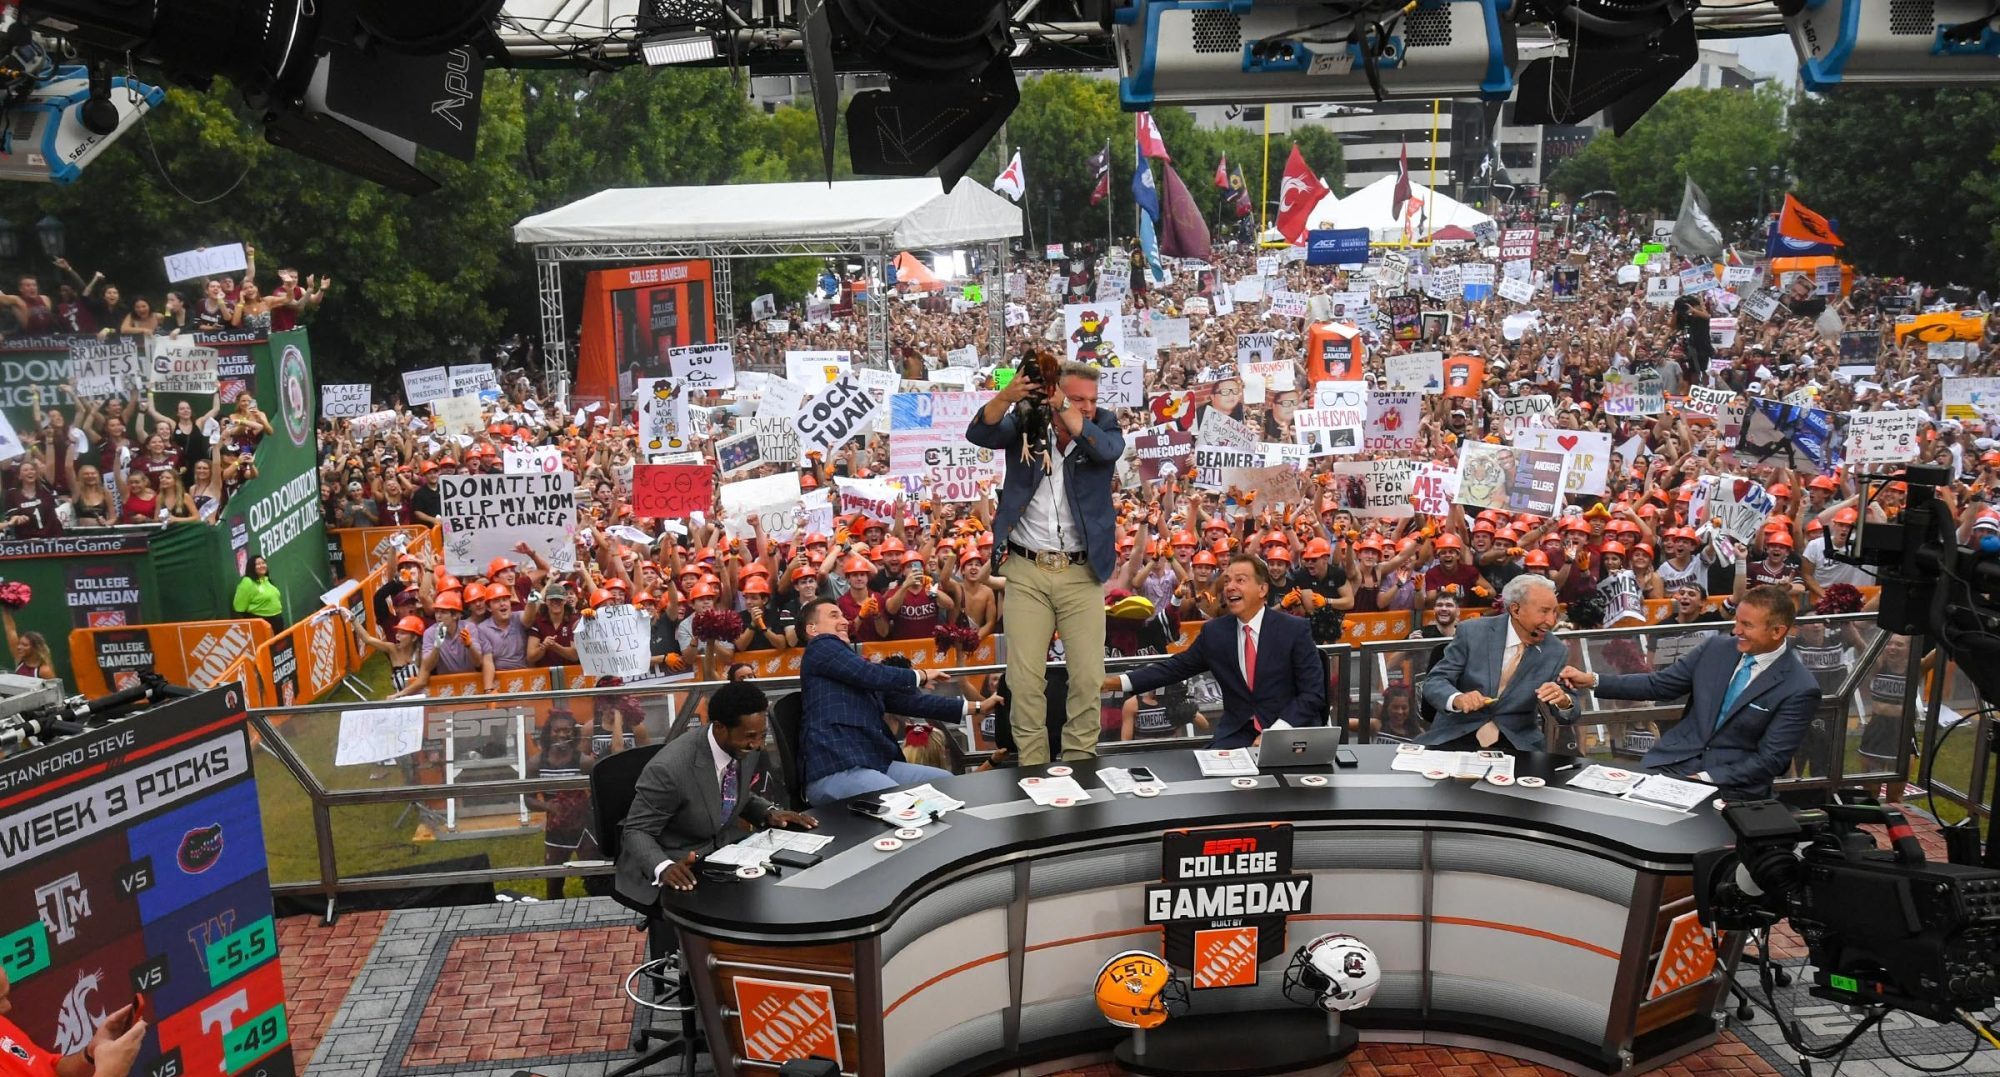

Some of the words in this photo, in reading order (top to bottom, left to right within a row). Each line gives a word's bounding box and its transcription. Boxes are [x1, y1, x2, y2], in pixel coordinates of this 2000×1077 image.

[1504, 230, 1536, 240] ESPN
[1312, 239, 1337, 249] ACC
[1502, 246, 1532, 257] COCKS
[170, 251, 238, 277] RANCH
[629, 270, 659, 284] COLLEGE
[660, 265, 689, 283] GAMEDAY
[1239, 335, 1274, 349] BRYAN
[71, 346, 108, 361] BRIAN
[167, 348, 182, 357] WE
[669, 347, 687, 357] GET
[688, 344, 730, 356] SWAMPED
[1322, 352, 1353, 360] GAMEDAY
[73, 355, 133, 378] HATES
[689, 356, 713, 366] LSU
[154, 381, 182, 391] BETTER
[406, 377, 419, 386] PAT
[419, 374, 444, 384] MCAFEE
[454, 377, 475, 388] BRIAN
[474, 372, 495, 385] KELLY
[322, 384, 371, 394] MCAFEE
[411, 387, 447, 399] PRESIDENT
[1690, 387, 1735, 405] GEAUX
[334, 393, 363, 403] LOVES
[656, 400, 672, 409] EAT
[798, 375, 860, 434] COCK
[1378, 398, 1408, 406] CAJUN
[325, 402, 368, 417] COCKS
[1503, 397, 1554, 417] GEAUX
[811, 392, 875, 450] TUAH
[1225, 416, 1256, 442] ALWAYS
[1851, 416, 1874, 426] LSU
[783, 433, 800, 447] FOR
[1157, 434, 1170, 446] GO
[1364, 438, 1413, 449] COCKS
[762, 446, 799, 461] KITTIES
[959, 447, 976, 456] IN
[1137, 443, 1192, 459] GAMECOCKS
[1281, 445, 1306, 456] EVIL
[516, 458, 532, 469] BY
[958, 456, 977, 465] THE
[1196, 450, 1254, 468] BEAMER
[1373, 460, 1411, 471] DYLAN
[653, 471, 692, 493] GO
[931, 466, 977, 482] STOP
[1365, 471, 1411, 483] STEWART
[441, 475, 535, 500] DONATE
[541, 474, 562, 492] TO
[1375, 482, 1402, 492] FOR
[1413, 476, 1443, 499] ME
[249, 498, 272, 532] OLD
[273, 466, 318, 518] DOMINION
[444, 497, 493, 518] HELP
[500, 496, 526, 514] MY
[533, 492, 574, 511] MOM
[259, 510, 301, 559] FREIGHT
[302, 499, 321, 532] LINE
[451, 513, 500, 533] BEAT
[505, 511, 568, 527] CANCER
[75, 576, 130, 590] COLLEGE
[67, 589, 140, 607] GAMEDAY
[604, 604, 633, 619] SPELL
[610, 618, 640, 637] KELLY
[101, 641, 146, 653] COLLEGE
[190, 632, 219, 660] THE
[615, 637, 624, 653] 2
[99, 652, 153, 668] GAMEDAY
[273, 647, 294, 667] COLLEGE
[272, 658, 297, 684] GAMEDAY
[428, 706, 536, 740] ESPN
[0, 748, 85, 791] STANFORD
[88, 729, 136, 760] STEVE
[0, 797, 97, 860] WEEK
[105, 784, 129, 816] 3
[136, 744, 231, 804] PICKS
[1203, 838, 1257, 855] ESPN
[1179, 851, 1278, 879] COLLEGE
[121, 869, 148, 894] VS
[1149, 880, 1310, 922] GAMEDAY
[1211, 919, 1232, 928] BUILT
[1232, 919, 1243, 927] BY
[2, 934, 36, 971] -3
[216, 926, 267, 971] -5.5
[1203, 939, 1224, 958] THE
[1195, 928, 1258, 988] HOME
[1110, 962, 1153, 984] LSU
[1219, 951, 1256, 986] DEPOT
[138, 965, 163, 991] VS
[752, 992, 786, 1023] THE
[745, 988, 832, 1062] HOME
[233, 1014, 279, 1055] -49
